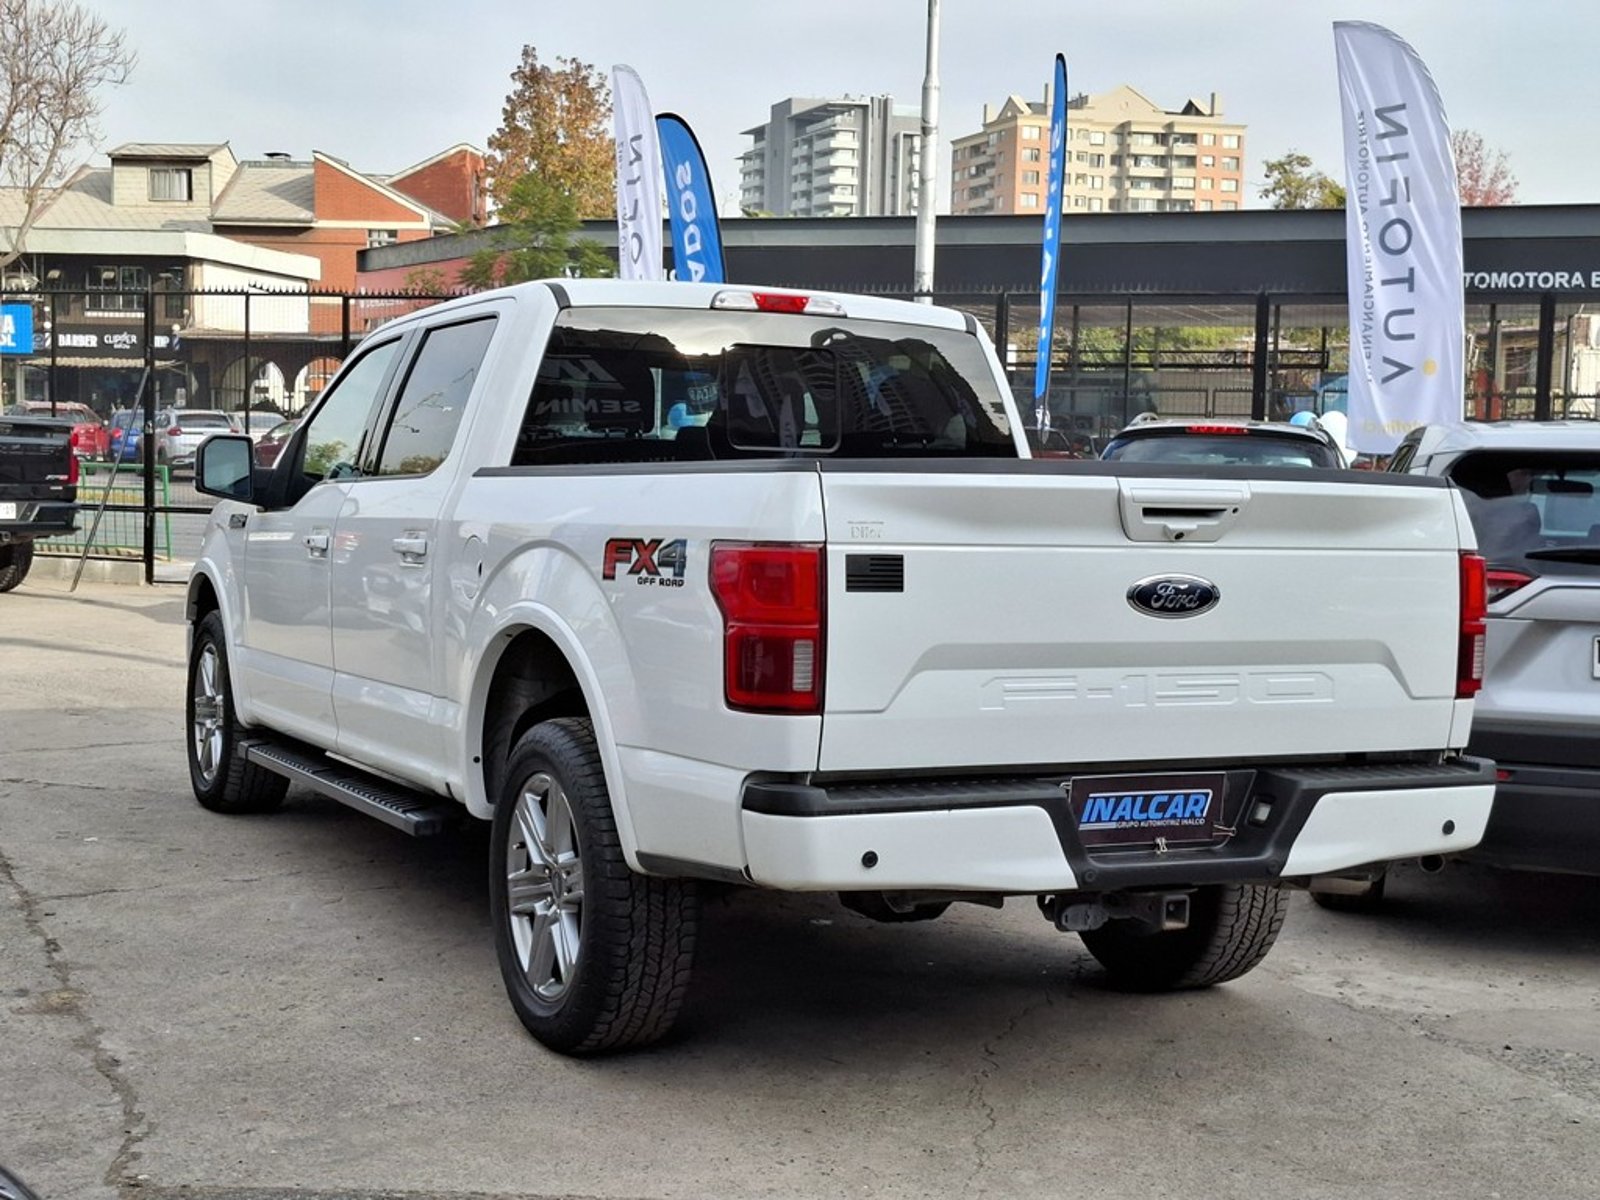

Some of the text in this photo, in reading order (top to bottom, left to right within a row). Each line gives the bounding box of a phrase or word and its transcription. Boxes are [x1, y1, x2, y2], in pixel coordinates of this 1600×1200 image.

[603, 538, 687, 580] FX4
[637, 577, 685, 587] OFF ROAD
[1151, 582, 1201, 609] Ford
[980, 671, 1335, 711] F-150
[1081, 794, 1207, 822] INALCAR
